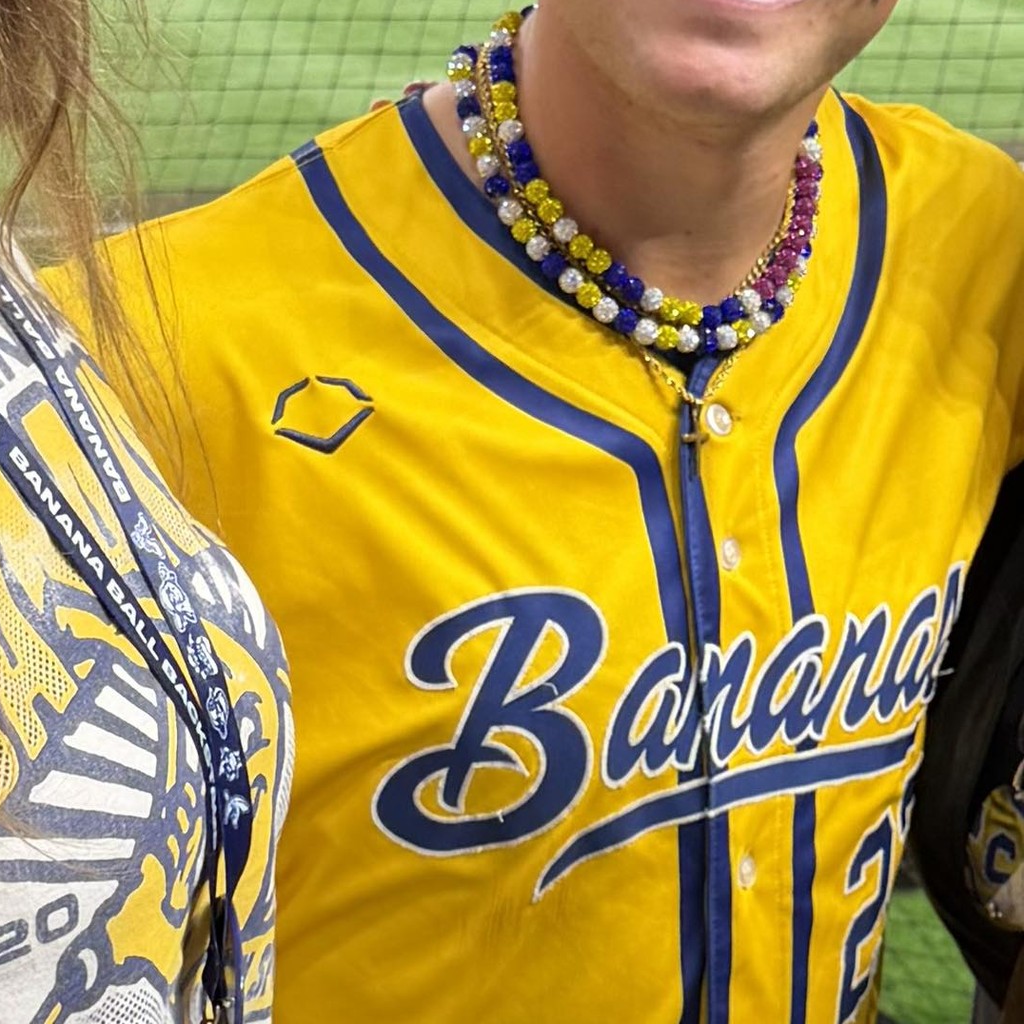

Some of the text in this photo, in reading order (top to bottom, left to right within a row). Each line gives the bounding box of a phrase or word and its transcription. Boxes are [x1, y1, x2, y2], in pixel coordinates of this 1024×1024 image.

[0, 284, 55, 359] BALL
[55, 364, 131, 503] BANANA
[8, 445, 105, 581] BANANA
[106, 578, 159, 661] BALL
